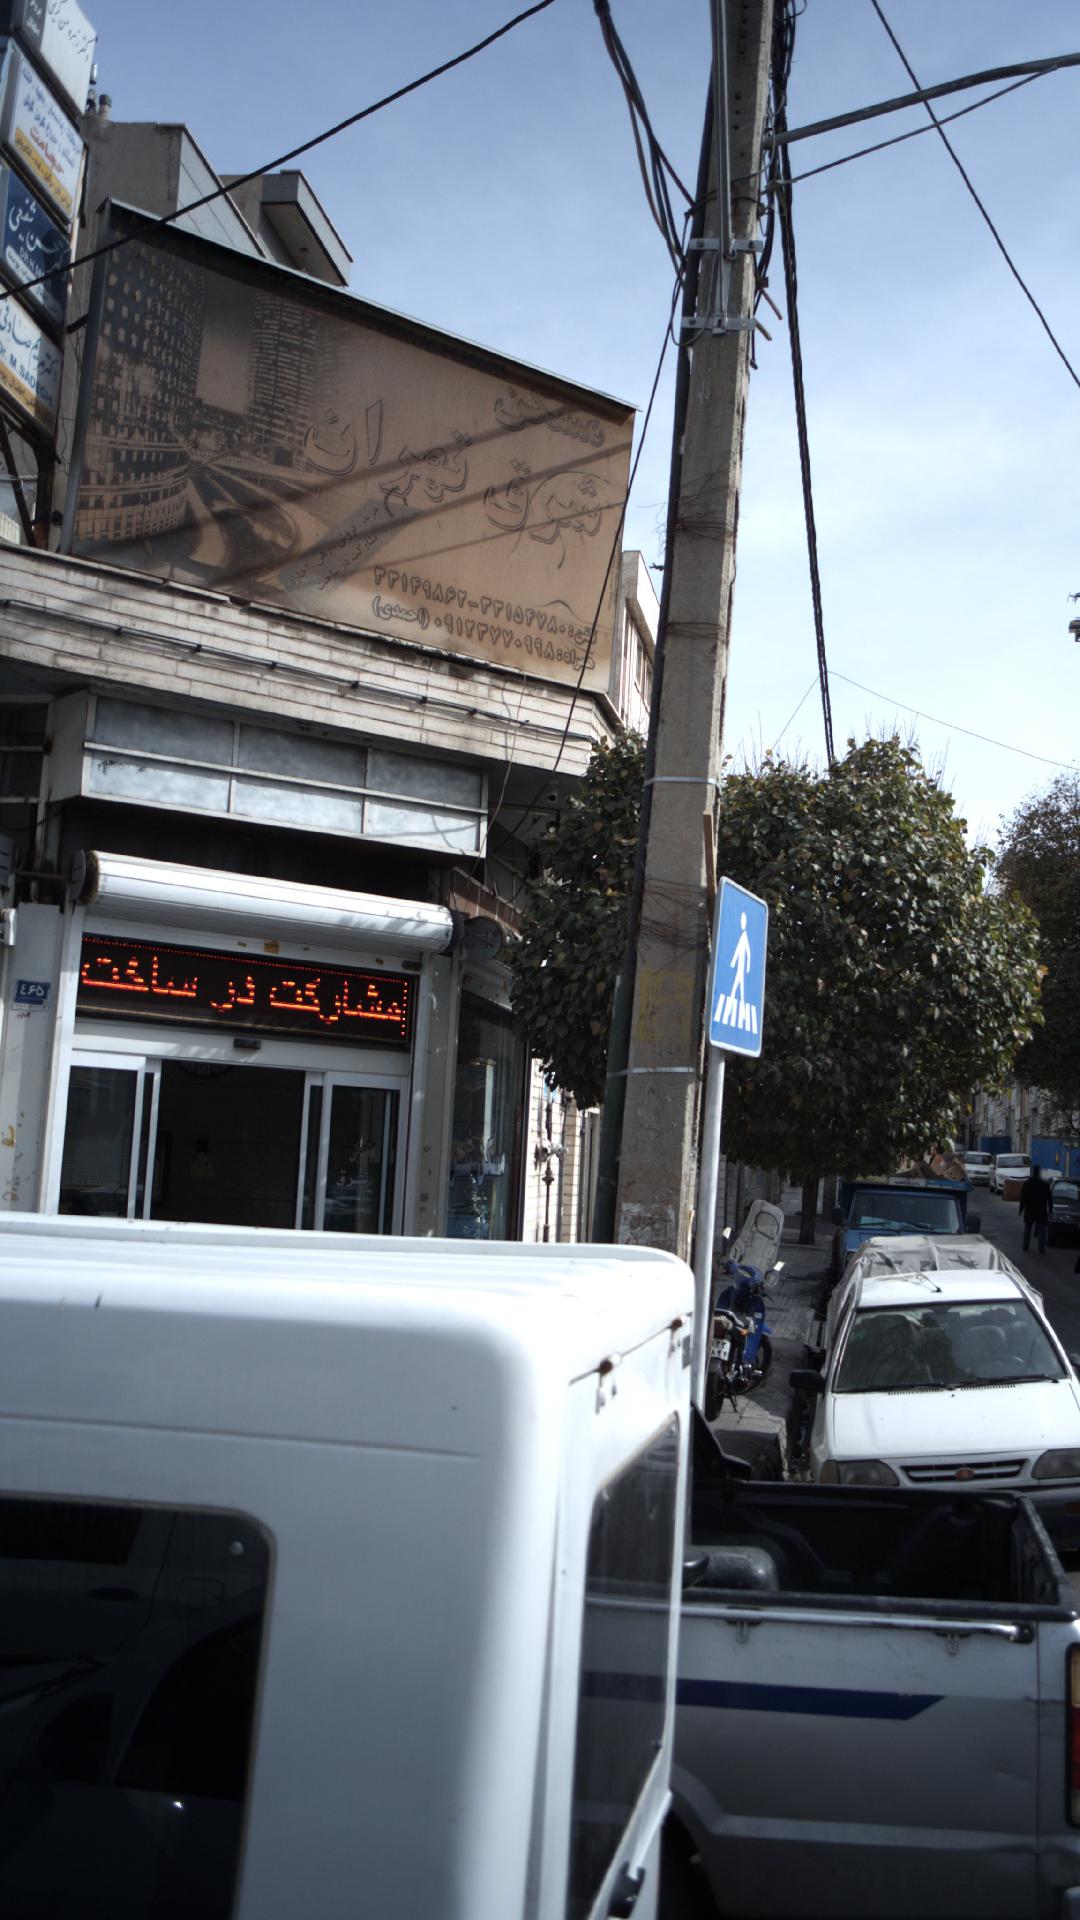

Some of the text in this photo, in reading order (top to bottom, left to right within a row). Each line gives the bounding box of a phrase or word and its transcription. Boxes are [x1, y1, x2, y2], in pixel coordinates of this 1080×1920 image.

[304, 400, 474, 503] تهران
[82, 955, 401, 1024] مشارکت در ساخت
